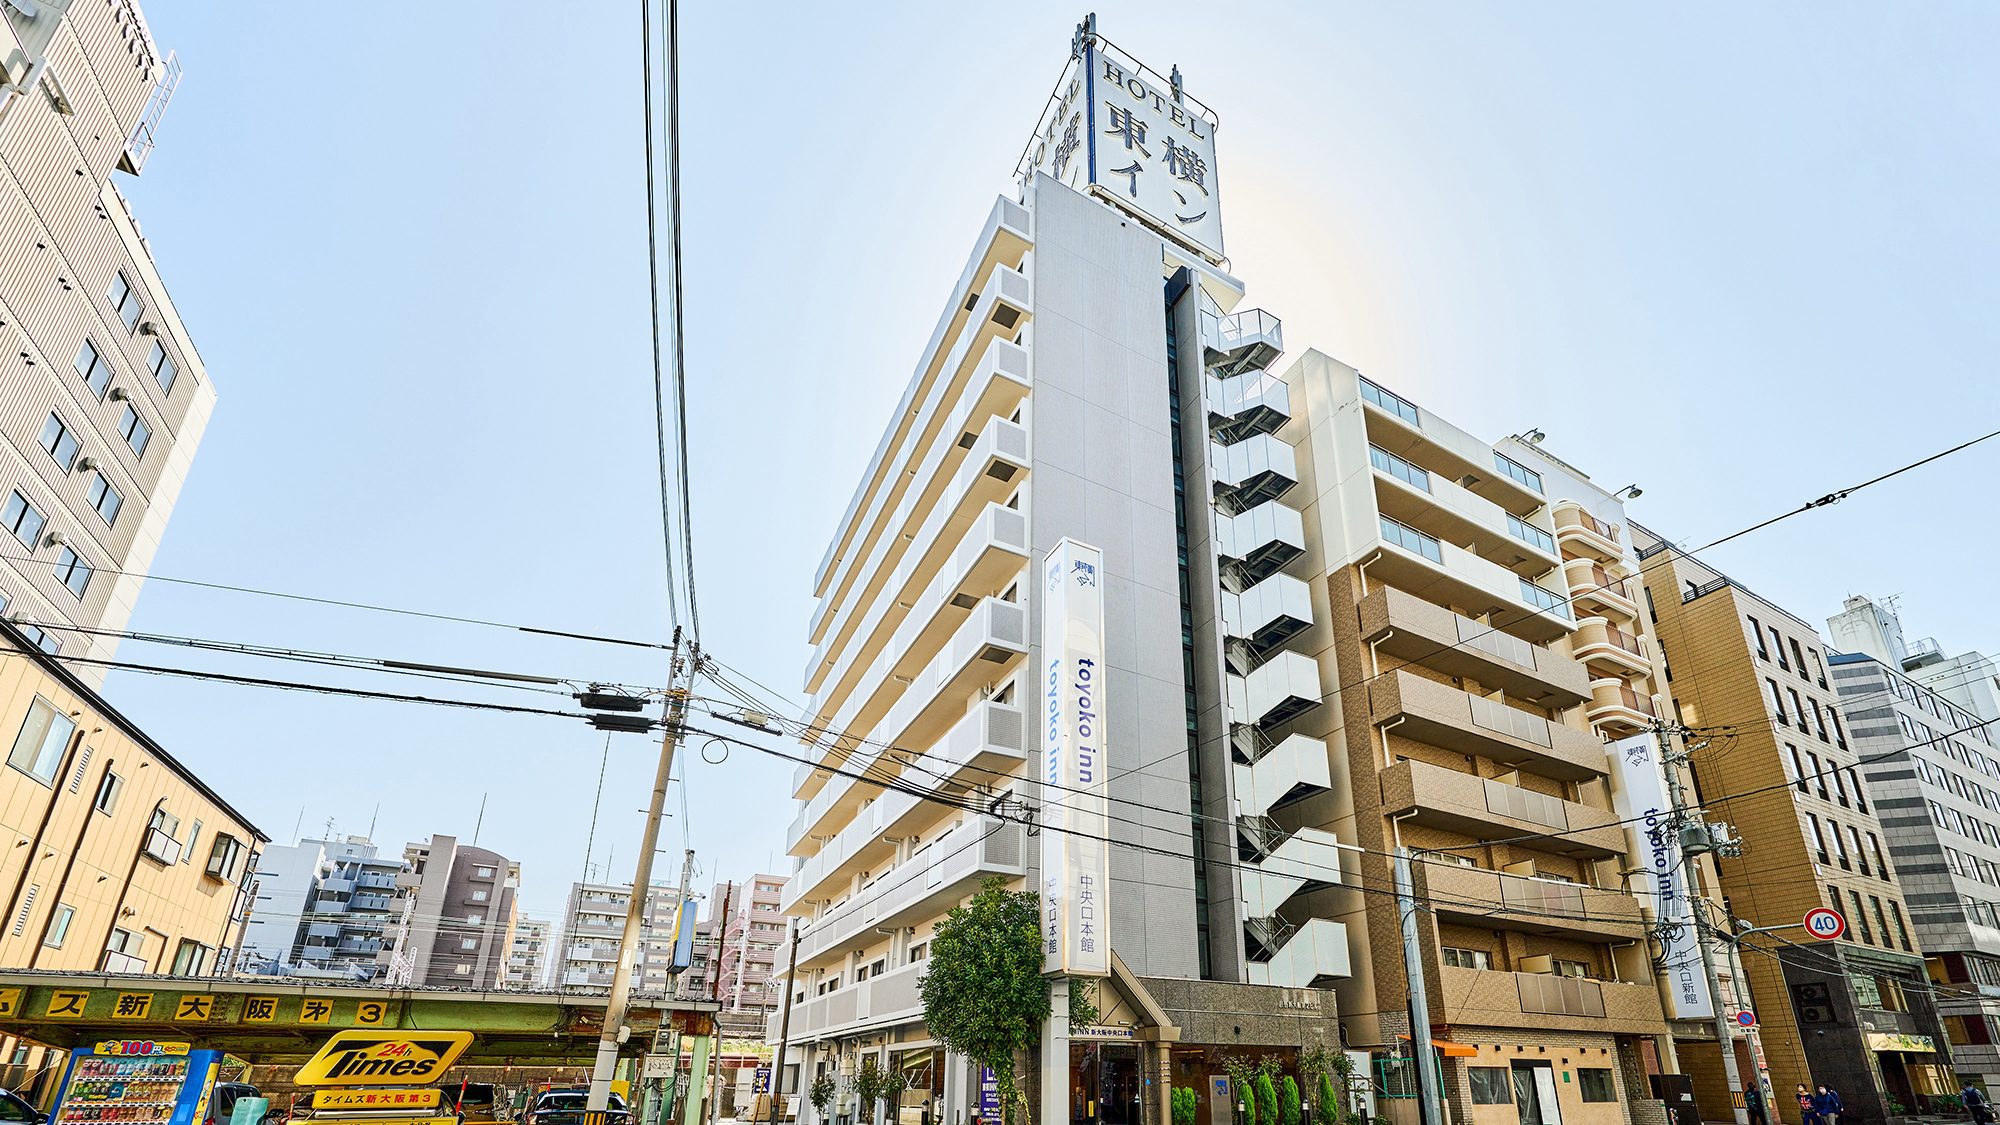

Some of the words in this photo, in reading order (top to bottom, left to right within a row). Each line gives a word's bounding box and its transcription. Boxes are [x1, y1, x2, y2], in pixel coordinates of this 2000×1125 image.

[1103, 60, 1206, 140] HOTEL
[1104, 100, 1209, 197] 東横
[1109, 159, 1208, 226] イン
[1047, 659, 1060, 741] toyoko
[1075, 658, 1096, 738] toyoko
[1049, 747, 1060, 785] inn
[1079, 745, 1096, 783] inn
[1644, 807, 1668, 868] toyoko
[1657, 872, 1674, 901] inn
[1048, 876, 1057, 955] 中央口本館
[1080, 874, 1095, 953] 中央口本館
[1813, 915, 1837, 932] 40
[1674, 950, 1698, 1005] 中央口新館
[322, 1094, 432, 1105] タイムズ新大阪第3
[325, 1051, 437, 1079] Times
